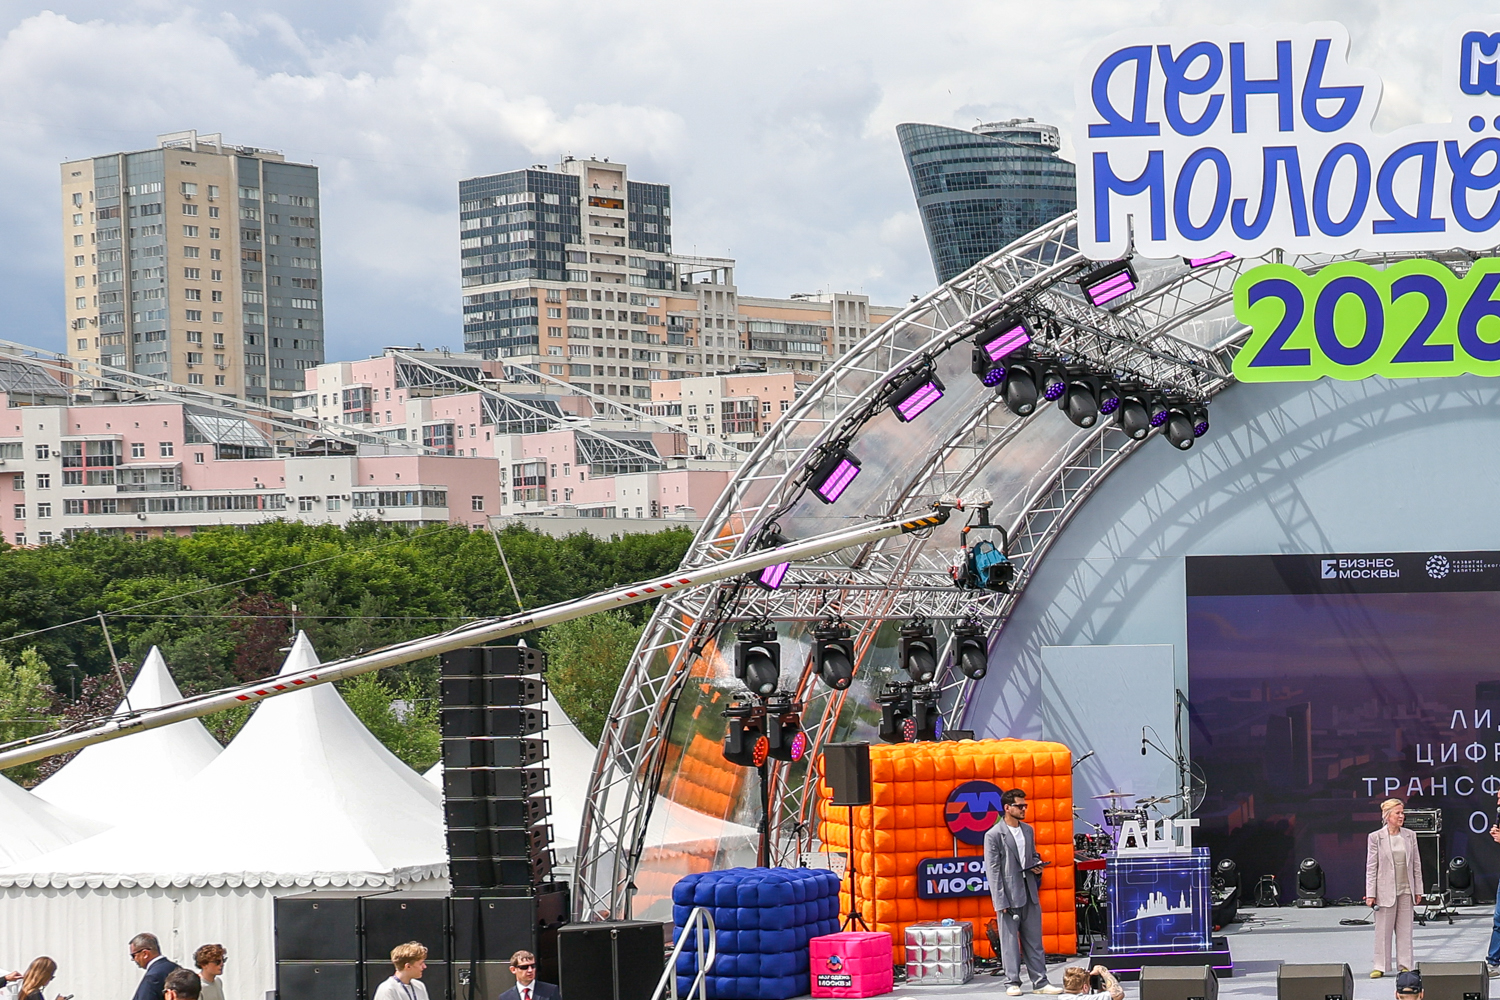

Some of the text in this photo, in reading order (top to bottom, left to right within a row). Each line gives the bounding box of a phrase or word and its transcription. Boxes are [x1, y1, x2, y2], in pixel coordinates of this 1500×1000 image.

[1339, 558, 1394, 568] БИЗНЕС
[1339, 569, 1400, 579] МОСКВЫ
[1117, 818, 1200, 853] АЦТ
